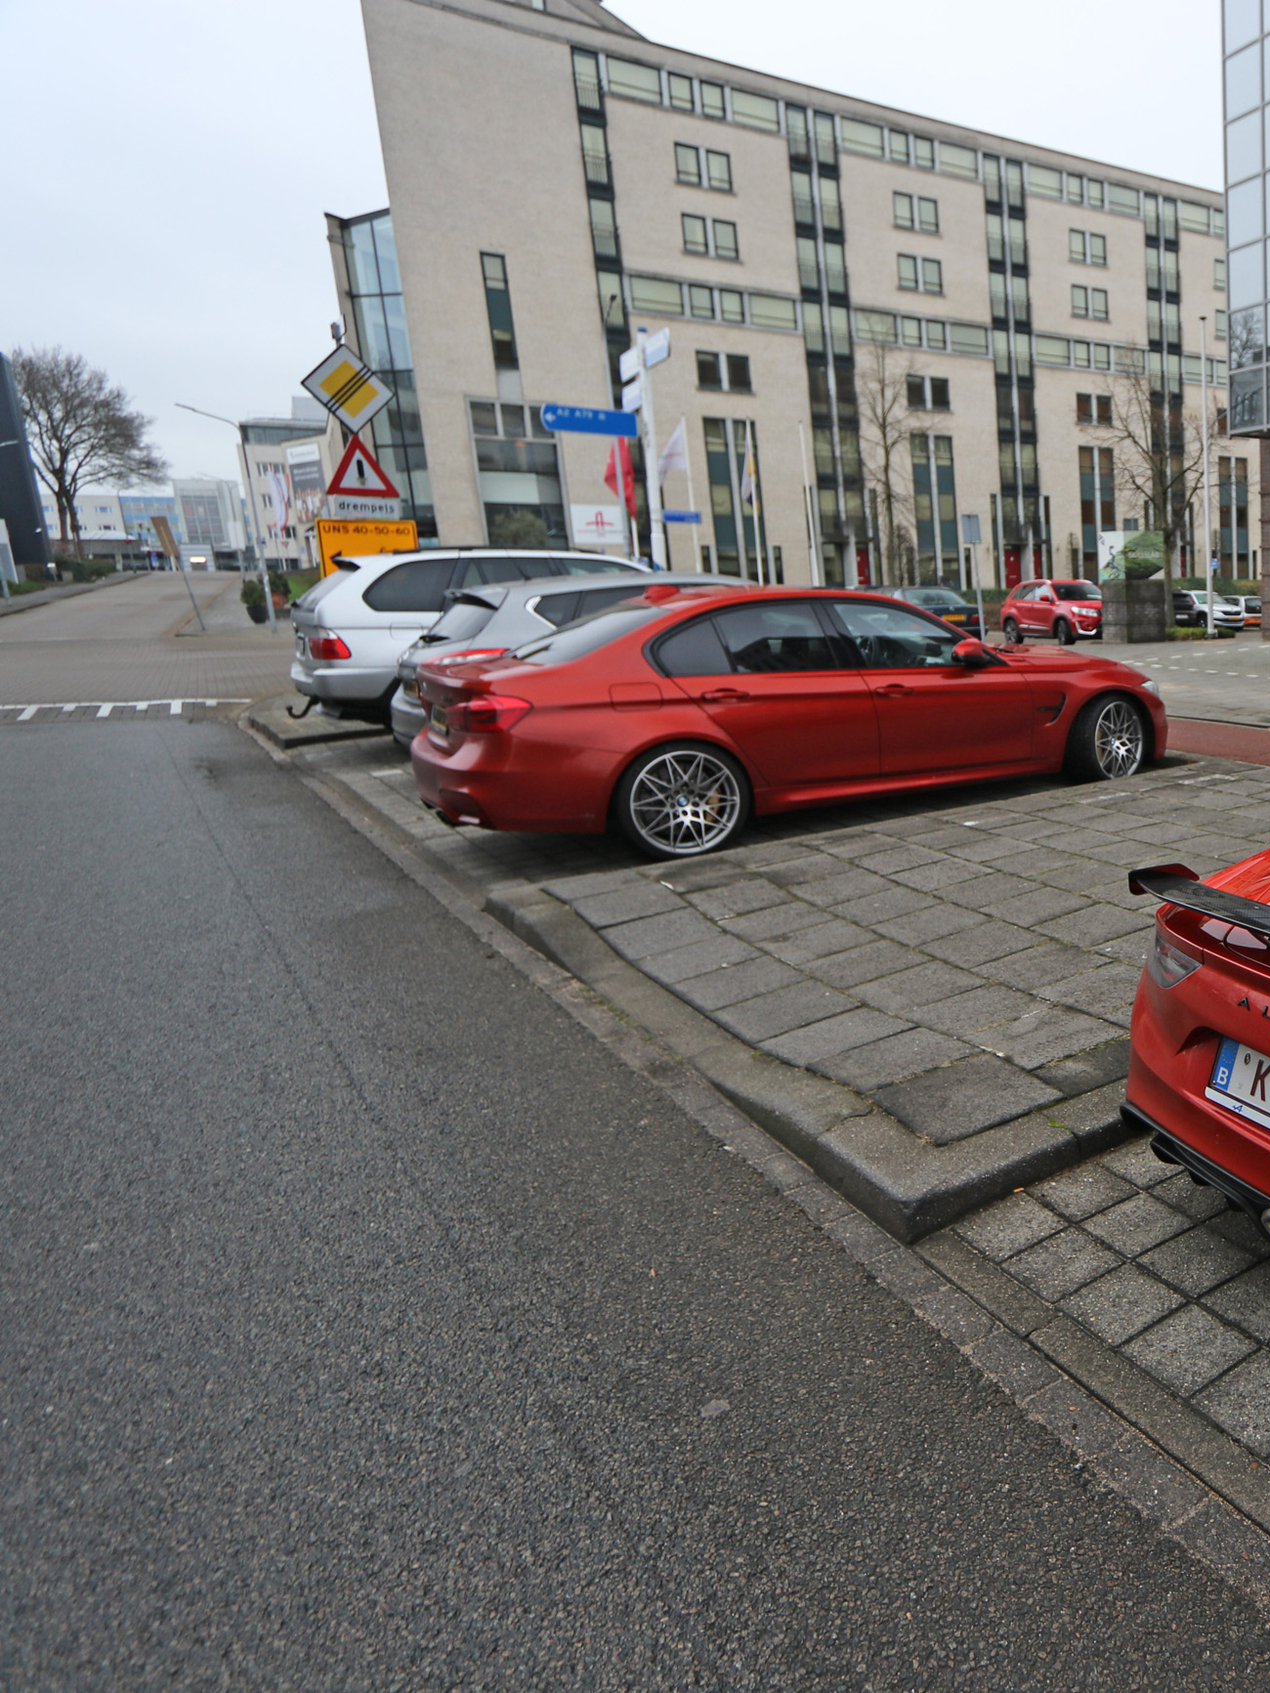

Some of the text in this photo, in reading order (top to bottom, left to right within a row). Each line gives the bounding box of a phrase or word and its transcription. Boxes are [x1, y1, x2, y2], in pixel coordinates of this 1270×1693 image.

[338, 500, 395, 514] drempels
[322, 524, 410, 536] UNS 40-50-60
[1217, 1067, 1229, 1085] B
